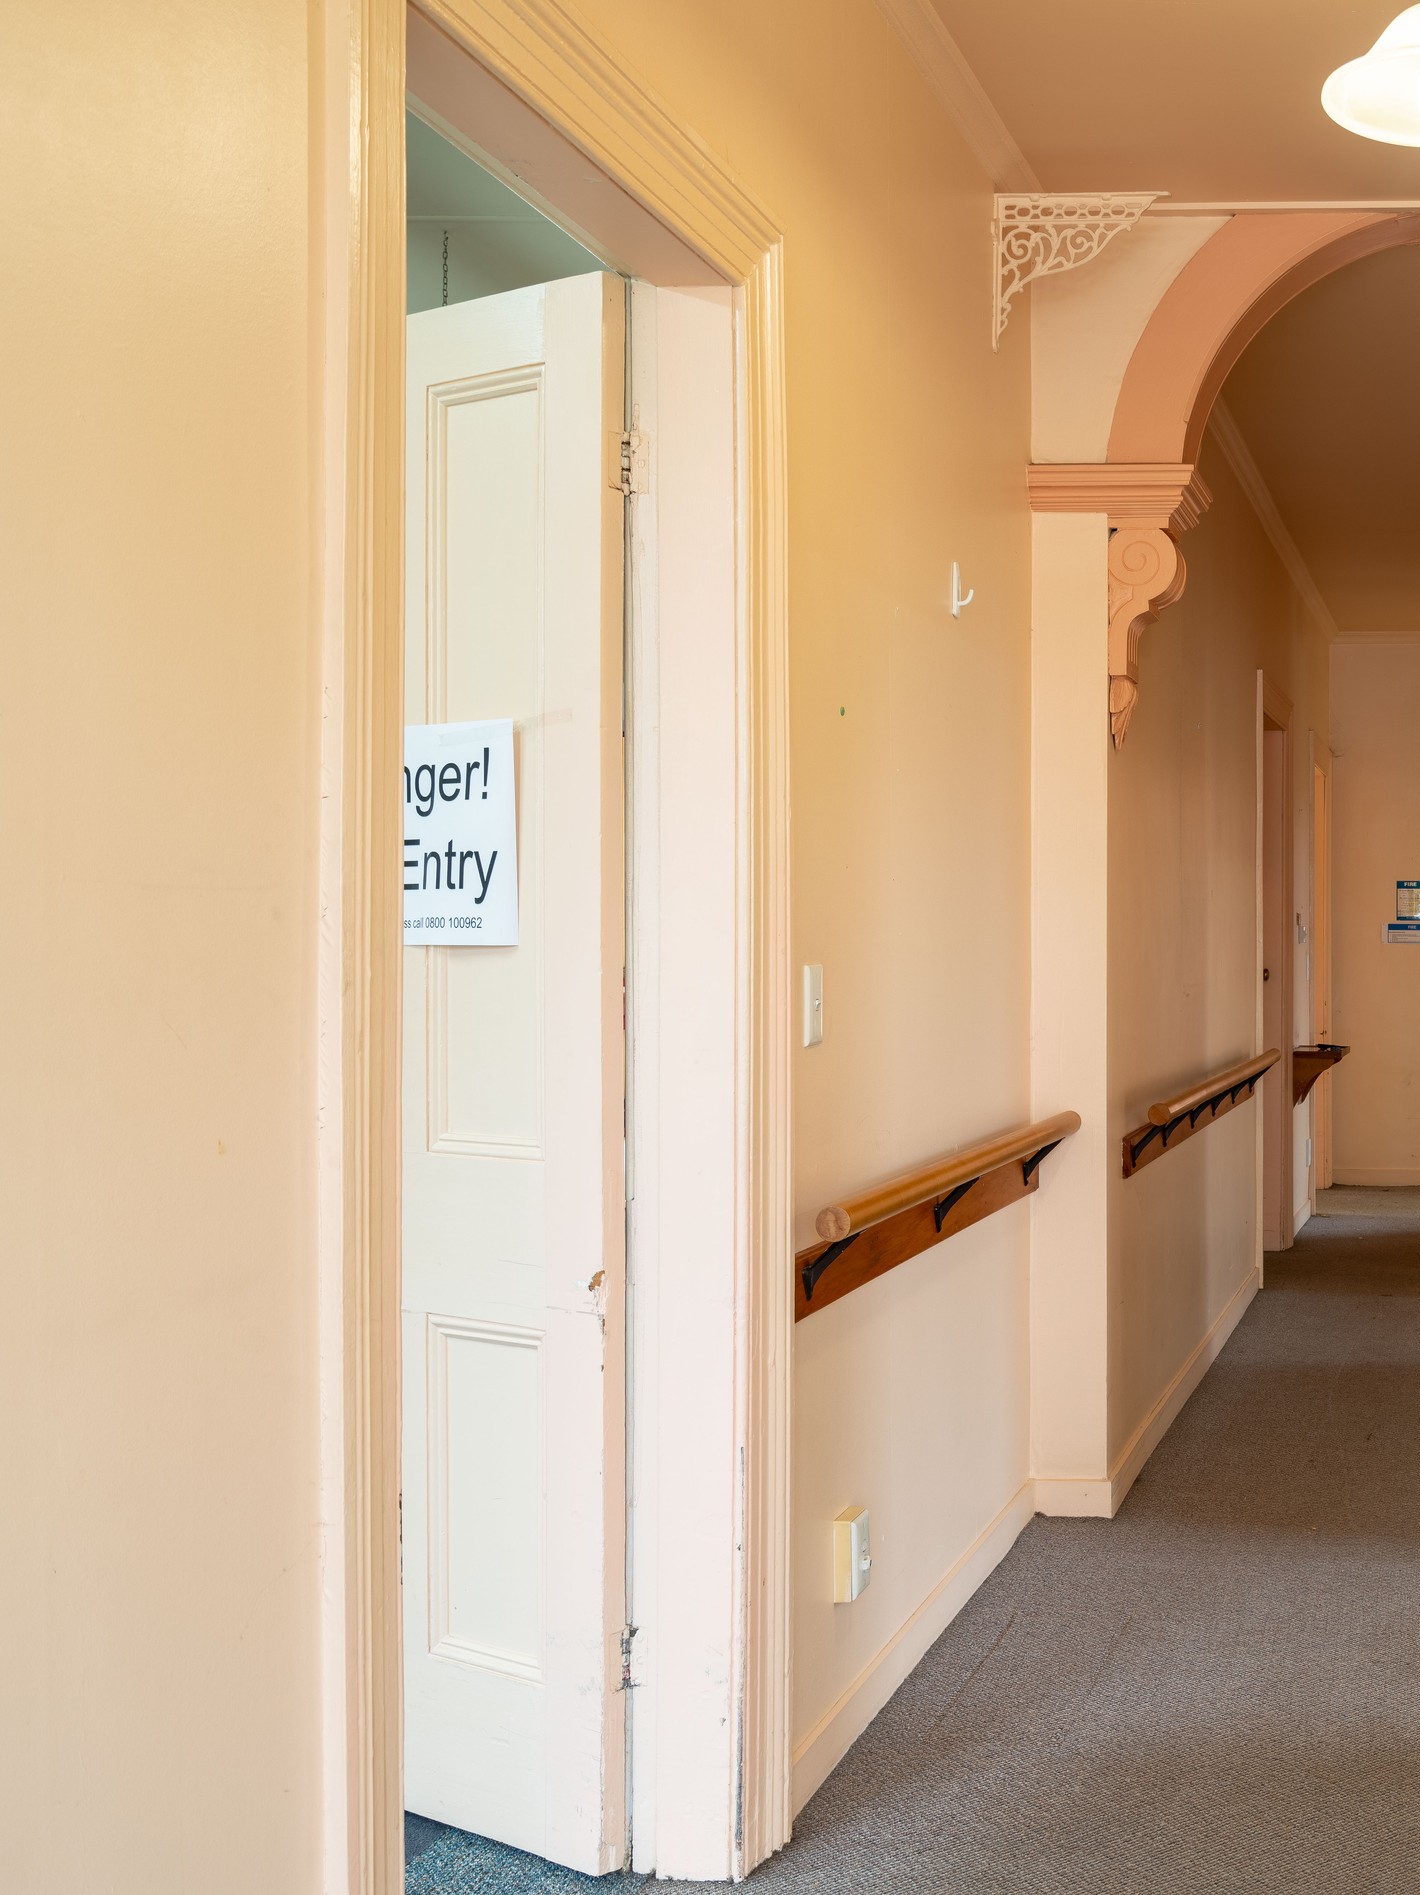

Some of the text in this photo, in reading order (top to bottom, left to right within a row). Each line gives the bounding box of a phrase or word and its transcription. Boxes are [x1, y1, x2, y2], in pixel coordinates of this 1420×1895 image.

[404, 839, 498, 904] Entry
[413, 917, 424, 928] call
[425, 917, 445, 928] 0800
[449, 917, 482, 928] 100962
